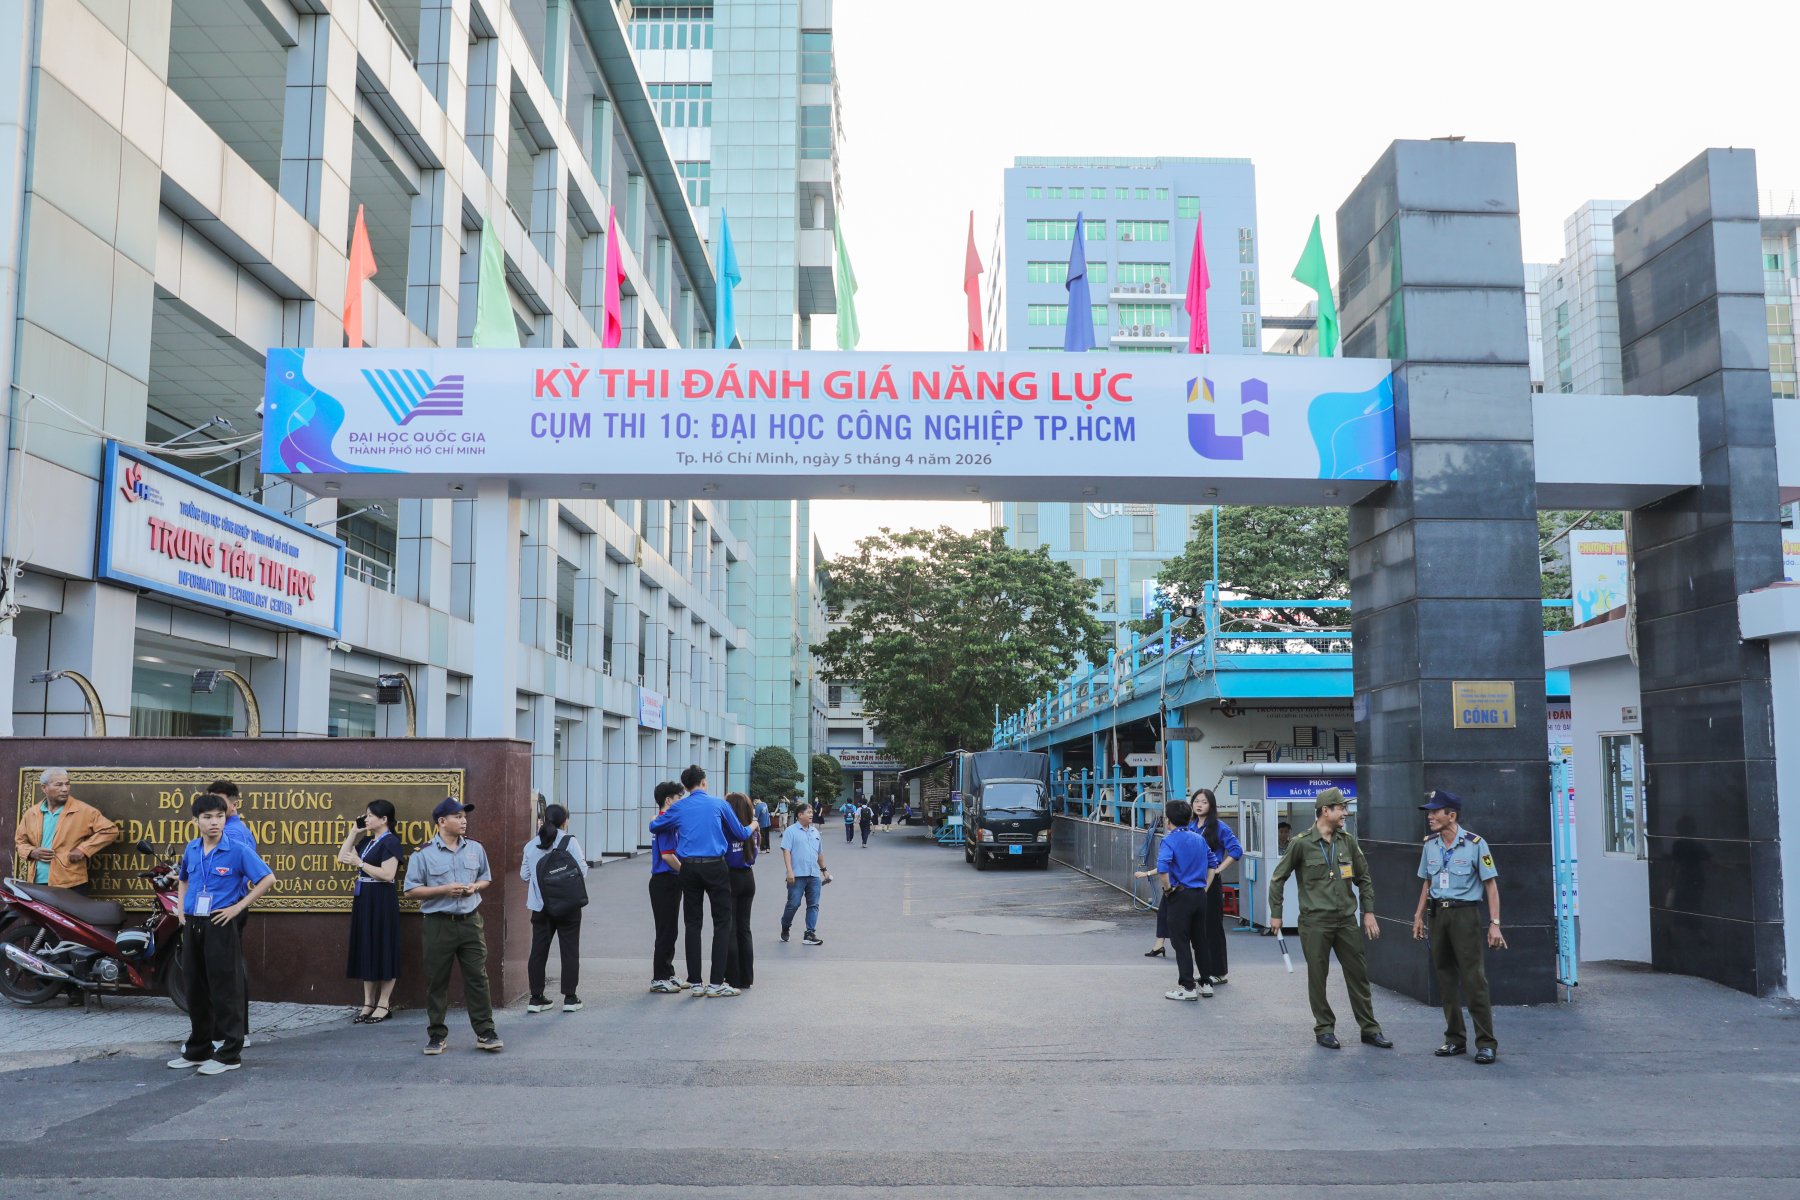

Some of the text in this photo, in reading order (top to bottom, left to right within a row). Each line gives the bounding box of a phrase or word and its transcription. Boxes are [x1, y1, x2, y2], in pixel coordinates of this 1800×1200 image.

[535, 363, 1133, 411] KỲ THI ĐÁNH GIÁ NĂNG LỰC
[349, 429, 486, 445] ĐẠI HỌC QUỐC GIA
[530, 409, 1135, 446] CỤM THI 10: ĐẠI HỌC CÔNG NGHIỆP TP.HCM
[348, 444, 486, 455] THÀNH PHỐ HỒ CHÍ MINH
[676, 450, 992, 468] Tp. Hồ Chí Minh, ngày 5 tháng 4 năm 2026
[1578, 540, 1627, 555] CHƯƠNG TRÌ
[148, 516, 316, 606] TRUNG TÂM TIN HỌC
[178, 569, 293, 616] INFORMATION TECHNOLOGY CENTER
[1463, 704, 1509, 724] CỔNG 1
[1552, 709, 1571, 720] ĐÁN
[158, 788, 184, 814] BỘ
[249, 789, 333, 810] THƯƠNG
[1289, 787, 1303, 795] BẢO
[1303, 788, 1312, 796] VỆ
[87, 853, 150, 871] STRIAL
[275, 854, 296, 871] HO
[300, 854, 328, 871] CHI
[91, 872, 121, 890] YỄN
[272, 876, 313, 893] QUẬN
[316, 875, 338, 891] GÒ
[340, 874, 359, 892] VẤ
